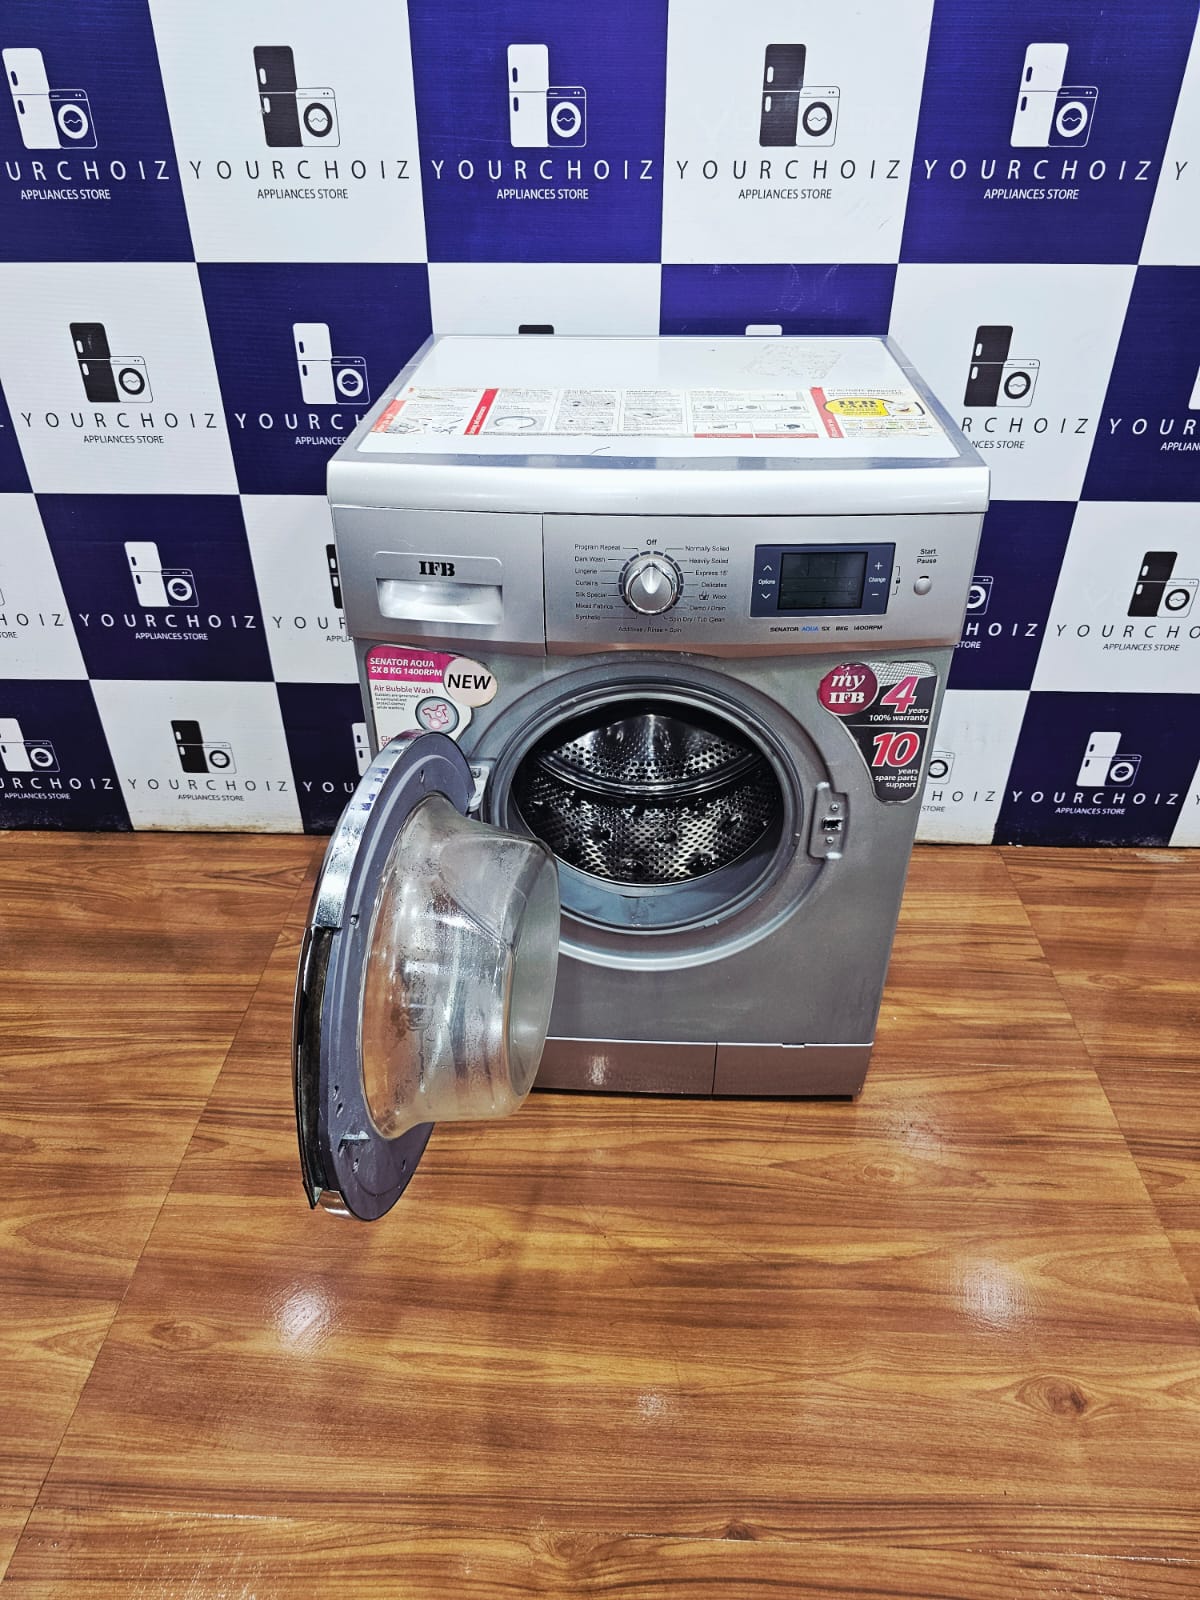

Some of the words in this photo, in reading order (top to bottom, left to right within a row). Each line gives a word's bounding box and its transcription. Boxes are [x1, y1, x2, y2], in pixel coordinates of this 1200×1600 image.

[190, 160, 409, 179] YOURCHOIZ
[432, 160, 652, 179] YOURCHOIZ
[677, 160, 900, 179] YOURCHOIZ
[925, 160, 1151, 180] YOURCHOIZ
[21, 189, 79, 199] APPLIANCES
[80, 189, 110, 199] STORE
[258, 189, 316, 199] APPLIANCES
[318, 189, 348, 199] STORE
[497, 189, 555, 199] APPLIANCES
[558, 189, 588, 199] STORE
[739, 189, 798, 199] APPLIANCES
[801, 189, 832, 199] STORE
[984, 189, 1045, 199] APPLIANCES
[1043, 189, 1079, 199] STORE
[21, 413, 216, 428] YOURCHOIZ
[84, 434, 135, 444] APPLIANCES
[137, 435, 163, 444] STORE
[996, 440, 1025, 449] STORE
[418, 561, 455, 576] IFB
[79, 614, 255, 628] YOURCHOIZ
[136, 632, 184, 640] APPLIANCES
[183, 632, 208, 641] STORE
[1103, 643, 1152, 651] APPLIANCES
[1155, 643, 1180, 652] STORE
[370, 657, 409, 666] SENATOR
[410, 659, 434, 668] AQUA
[371, 666, 382, 674] SX
[383, 666, 389, 674] 8
[390, 667, 402, 675] KG
[404, 667, 442, 677] 1400RPM
[447, 674, 491, 690] NEW
[831, 674, 866, 691] my
[386, 685, 412, 693] Bubble
[880, 675, 919, 713] 4
[829, 692, 864, 704] IFB
[892, 715, 928, 723] warranty
[872, 731, 920, 767] 10
[874, 775, 896, 783] spare
[897, 775, 917, 783] parts
[128, 779, 287, 791] YOURCHOIZ
[5, 792, 49, 800] APPLIANCES
[48, 792, 70, 800] STORE
[178, 793, 223, 801] APPLIANCES
[222, 794, 243, 802] STORE
[1013, 791, 1178, 804] YOURCHOIZ
[1055, 807, 1100, 815] APPLIANCES
[1102, 807, 1125, 815] STORE
